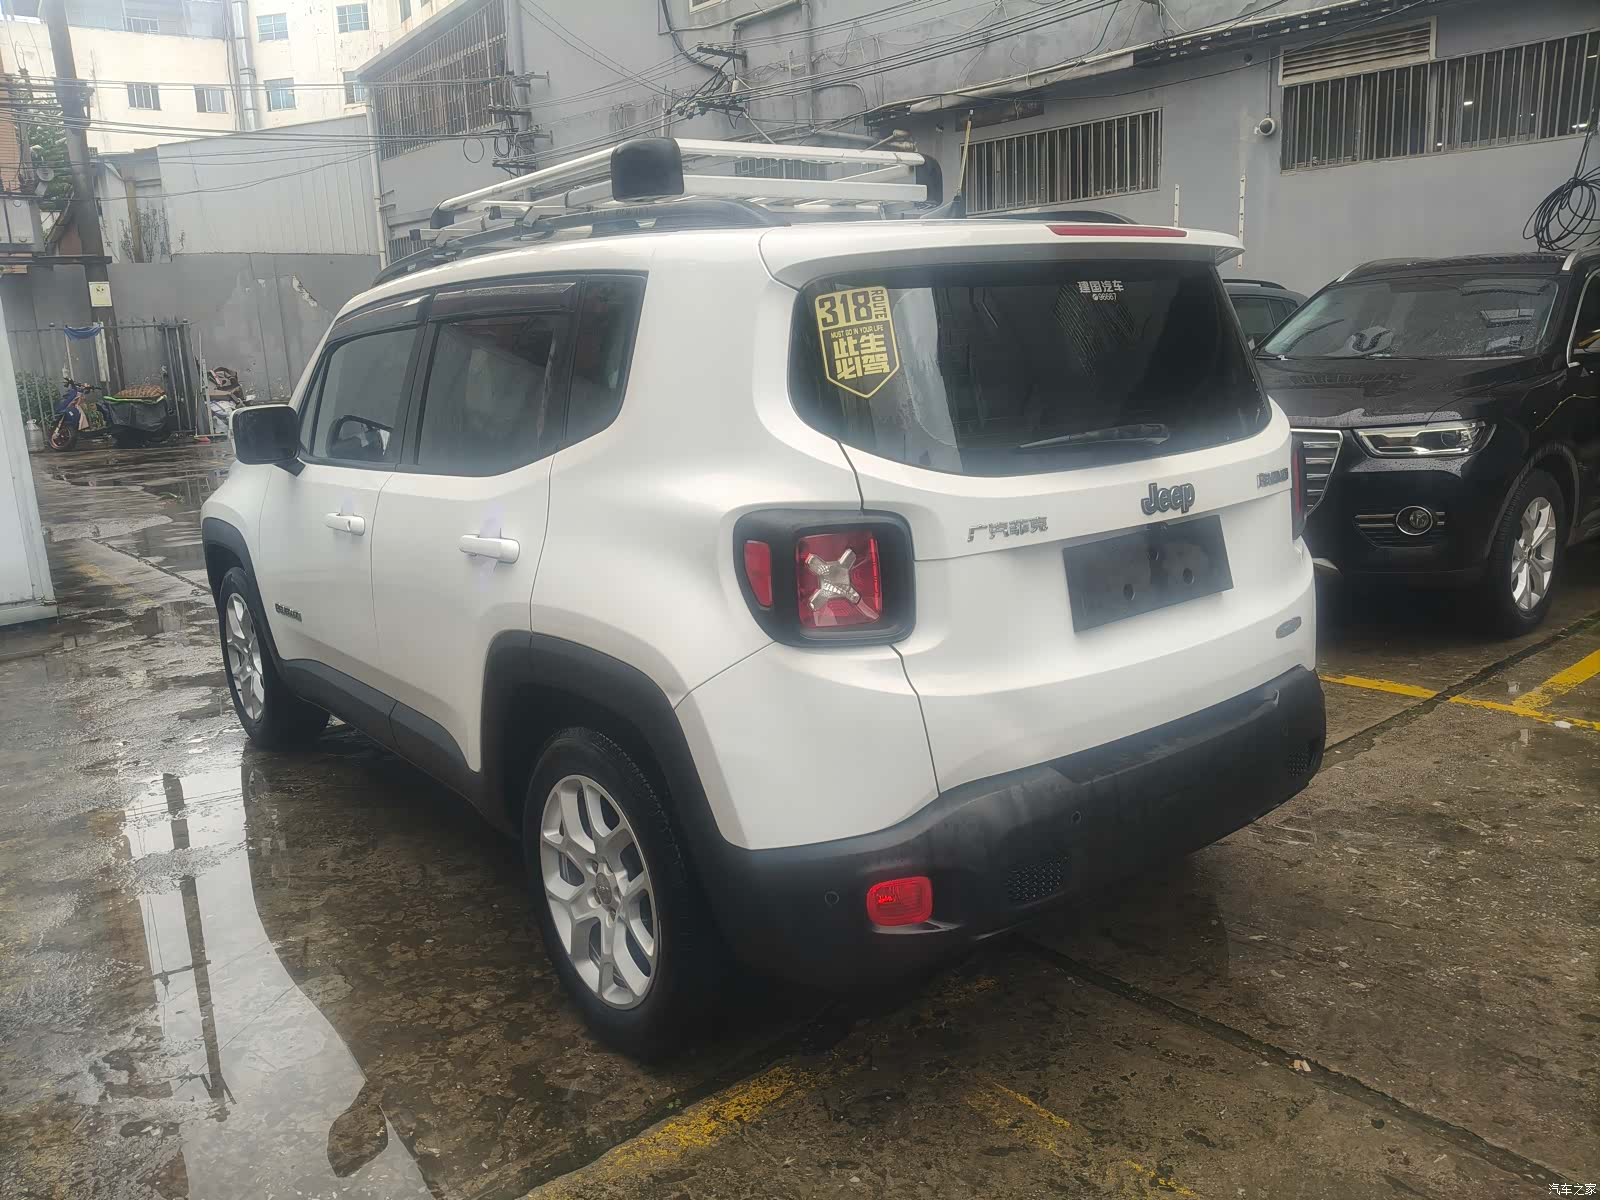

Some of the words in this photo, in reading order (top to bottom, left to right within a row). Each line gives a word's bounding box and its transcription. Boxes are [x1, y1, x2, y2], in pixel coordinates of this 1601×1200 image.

[1077, 280, 1124, 293] 建国汽车
[818, 290, 873, 328] 318
[871, 289, 888, 320] ROUTE
[830, 330, 845, 339] MUST
[845, 329, 853, 337] GO
[853, 327, 859, 335] IN
[859, 325, 874, 334] YOUR
[874, 324, 884, 332] LIFE
[833, 333, 887, 359] 此生
[835, 353, 891, 380] 必驾
[1141, 482, 1196, 516] Jeep
